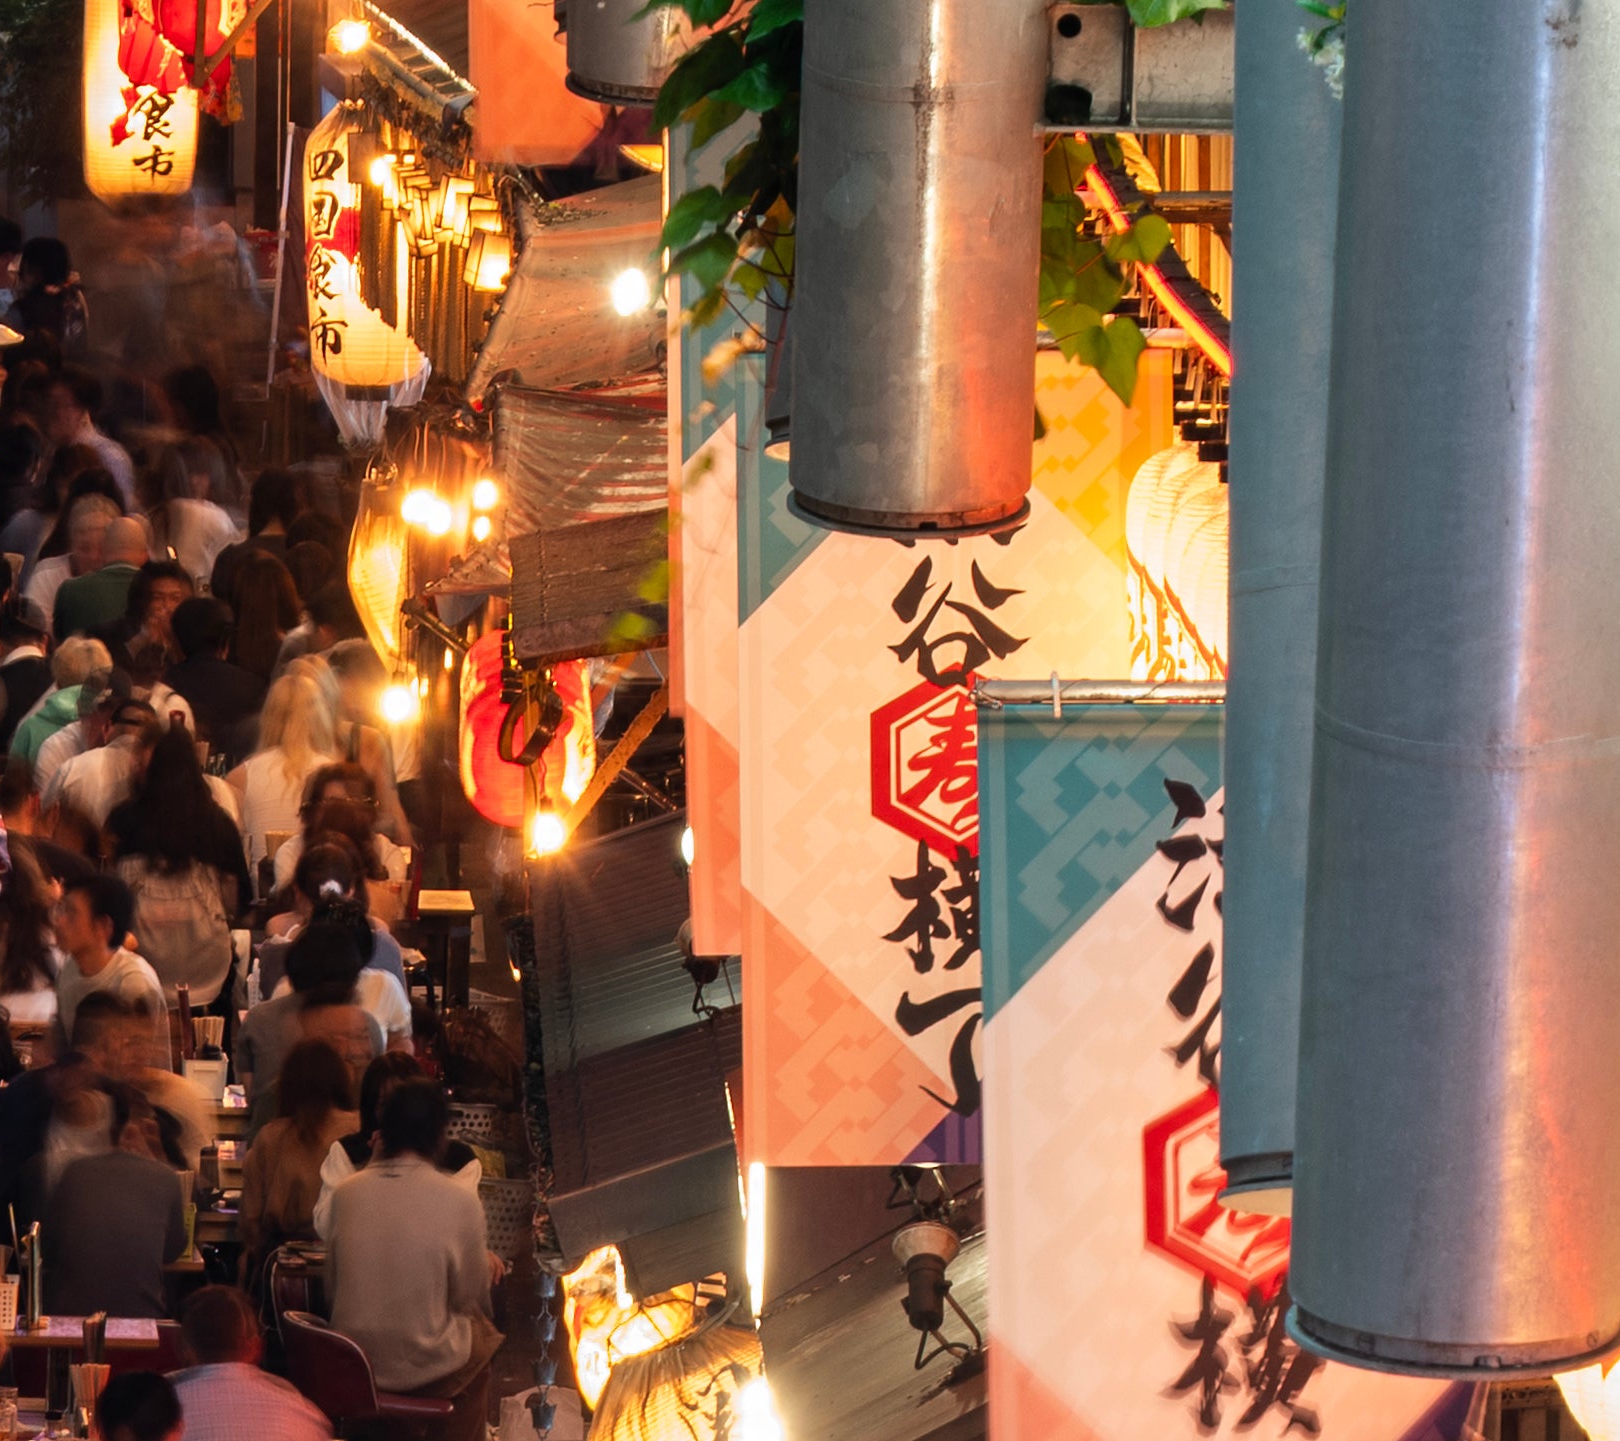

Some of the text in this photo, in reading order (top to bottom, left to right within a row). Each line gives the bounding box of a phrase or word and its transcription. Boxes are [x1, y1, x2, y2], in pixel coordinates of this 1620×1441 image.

[309, 149, 349, 365] 四国食市
[889, 525, 1031, 688] 谷
